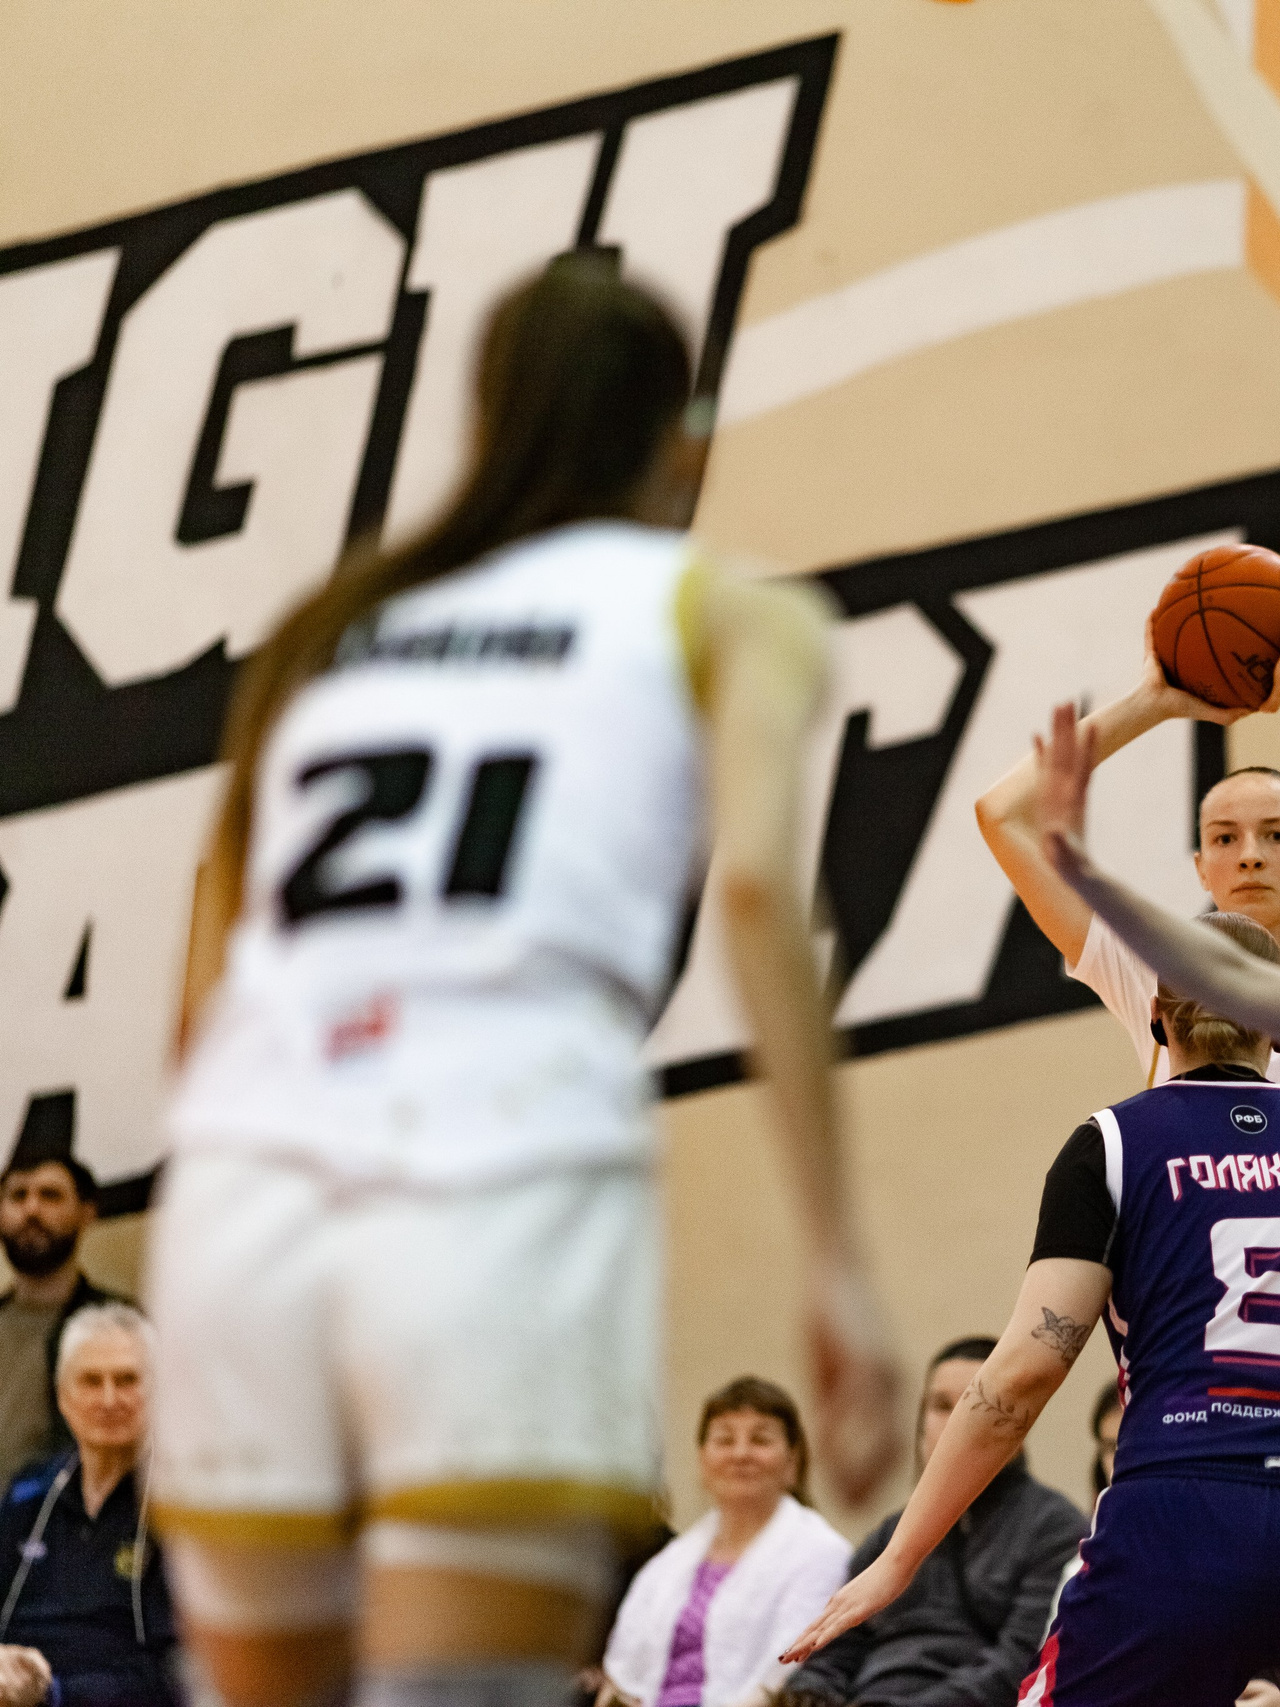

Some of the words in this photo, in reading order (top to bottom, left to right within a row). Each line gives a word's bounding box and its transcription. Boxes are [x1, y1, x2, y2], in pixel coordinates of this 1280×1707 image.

[279, 744, 541, 922] 21
[1235, 1114, 1263, 1124] РФБ
[1162, 1411, 1208, 1424] ФОНД
